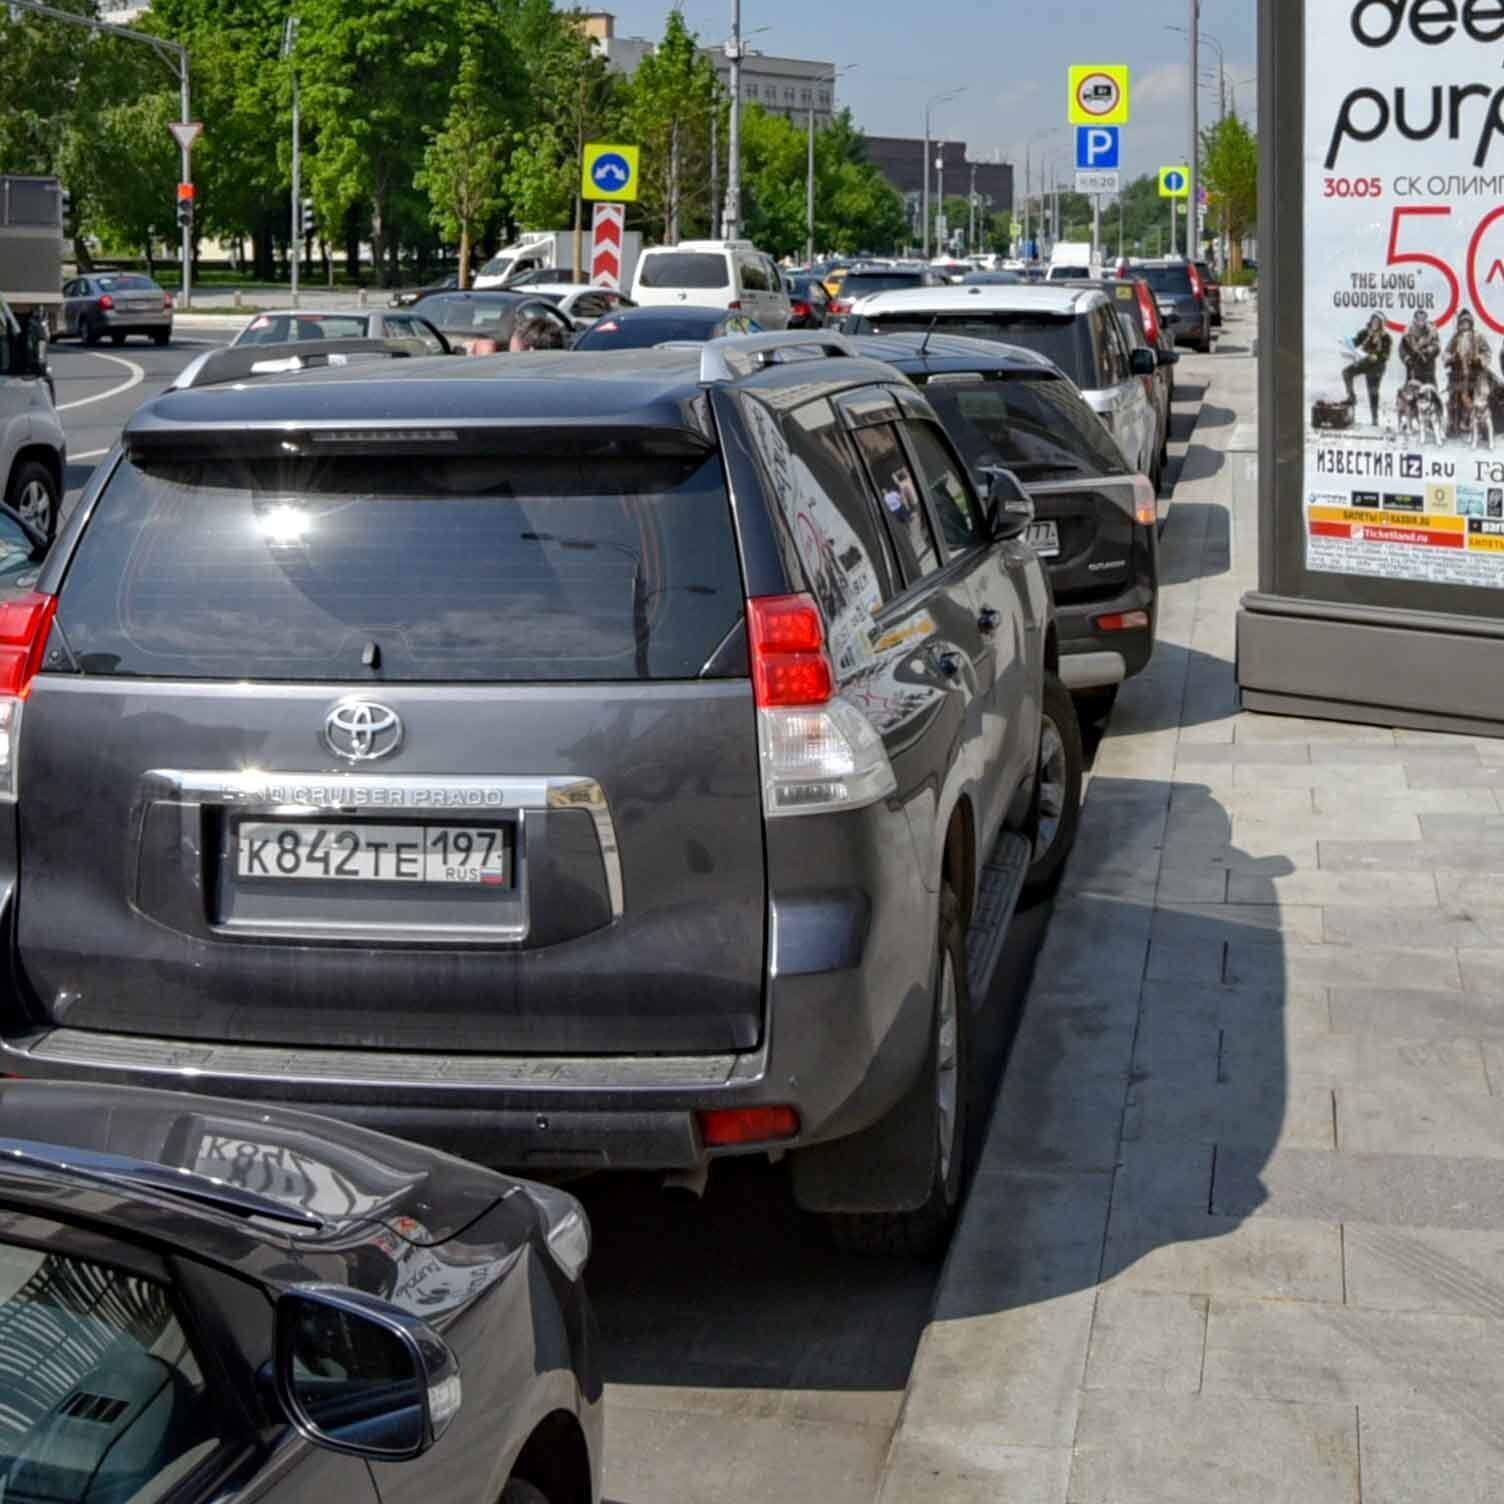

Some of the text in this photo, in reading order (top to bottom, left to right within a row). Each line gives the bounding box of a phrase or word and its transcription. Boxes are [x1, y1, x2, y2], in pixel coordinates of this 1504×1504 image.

[1087, 129, 1113, 165] P
[1324, 177, 1382, 197] 30.05
[1393, 176, 1422, 196] СК
[1350, 273, 1415, 290] THE LONG
[1333, 291, 1435, 309] GOODBYE TOUR
[1317, 449, 1393, 477] ИЗВЕСТИЯ
[1364, 526, 1429, 544] Ticketland.ru
[296, 787, 404, 805] CRUISER
[415, 788, 504, 806] PRADO
[247, 829, 496, 878] К842ТЕ 197
[446, 867, 478, 881] RUS
